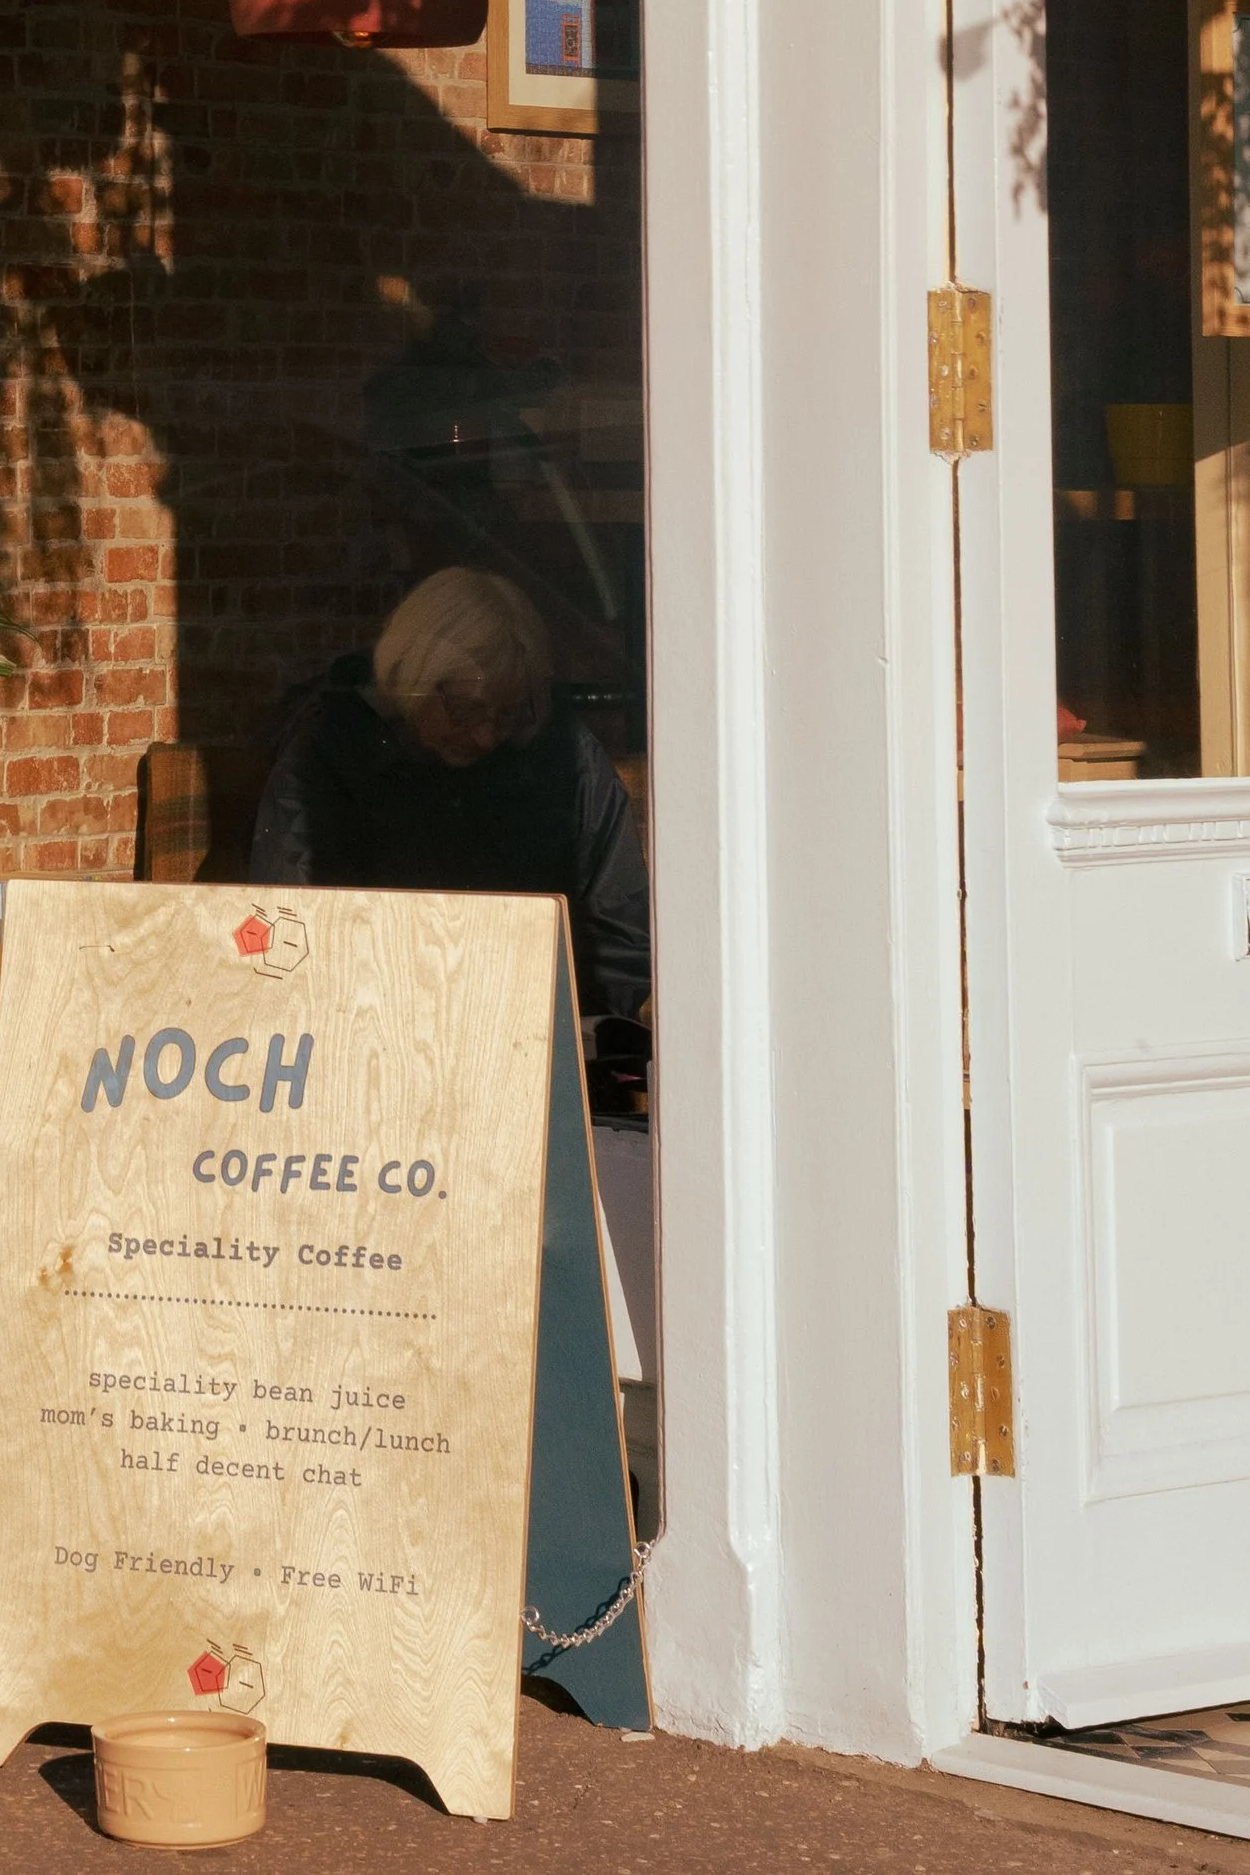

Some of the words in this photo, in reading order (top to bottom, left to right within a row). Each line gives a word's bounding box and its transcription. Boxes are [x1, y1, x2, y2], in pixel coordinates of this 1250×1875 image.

[81, 1027, 314, 1113] NOCH
[192, 1149, 359, 1194] COFFEE
[378, 1159, 447, 1200] CO.
[108, 1233, 280, 1267] Speciality
[298, 1244, 403, 1271] Coffee
[89, 1371, 237, 1402] speciality
[253, 1379, 313, 1403] bean
[330, 1385, 406, 1410] juice
[40, 1407, 114, 1428] mom's
[130, 1409, 220, 1441] baking
[265, 1420, 451, 1454] brunch/lunch
[120, 1449, 180, 1472] half
[196, 1456, 285, 1481] decent
[302, 1464, 362, 1487] chat
[54, 1546, 99, 1573] Dog
[113, 1551, 235, 1584] Friendly
[280, 1565, 342, 1589] Free
[357, 1572, 420, 1596] WiFi
